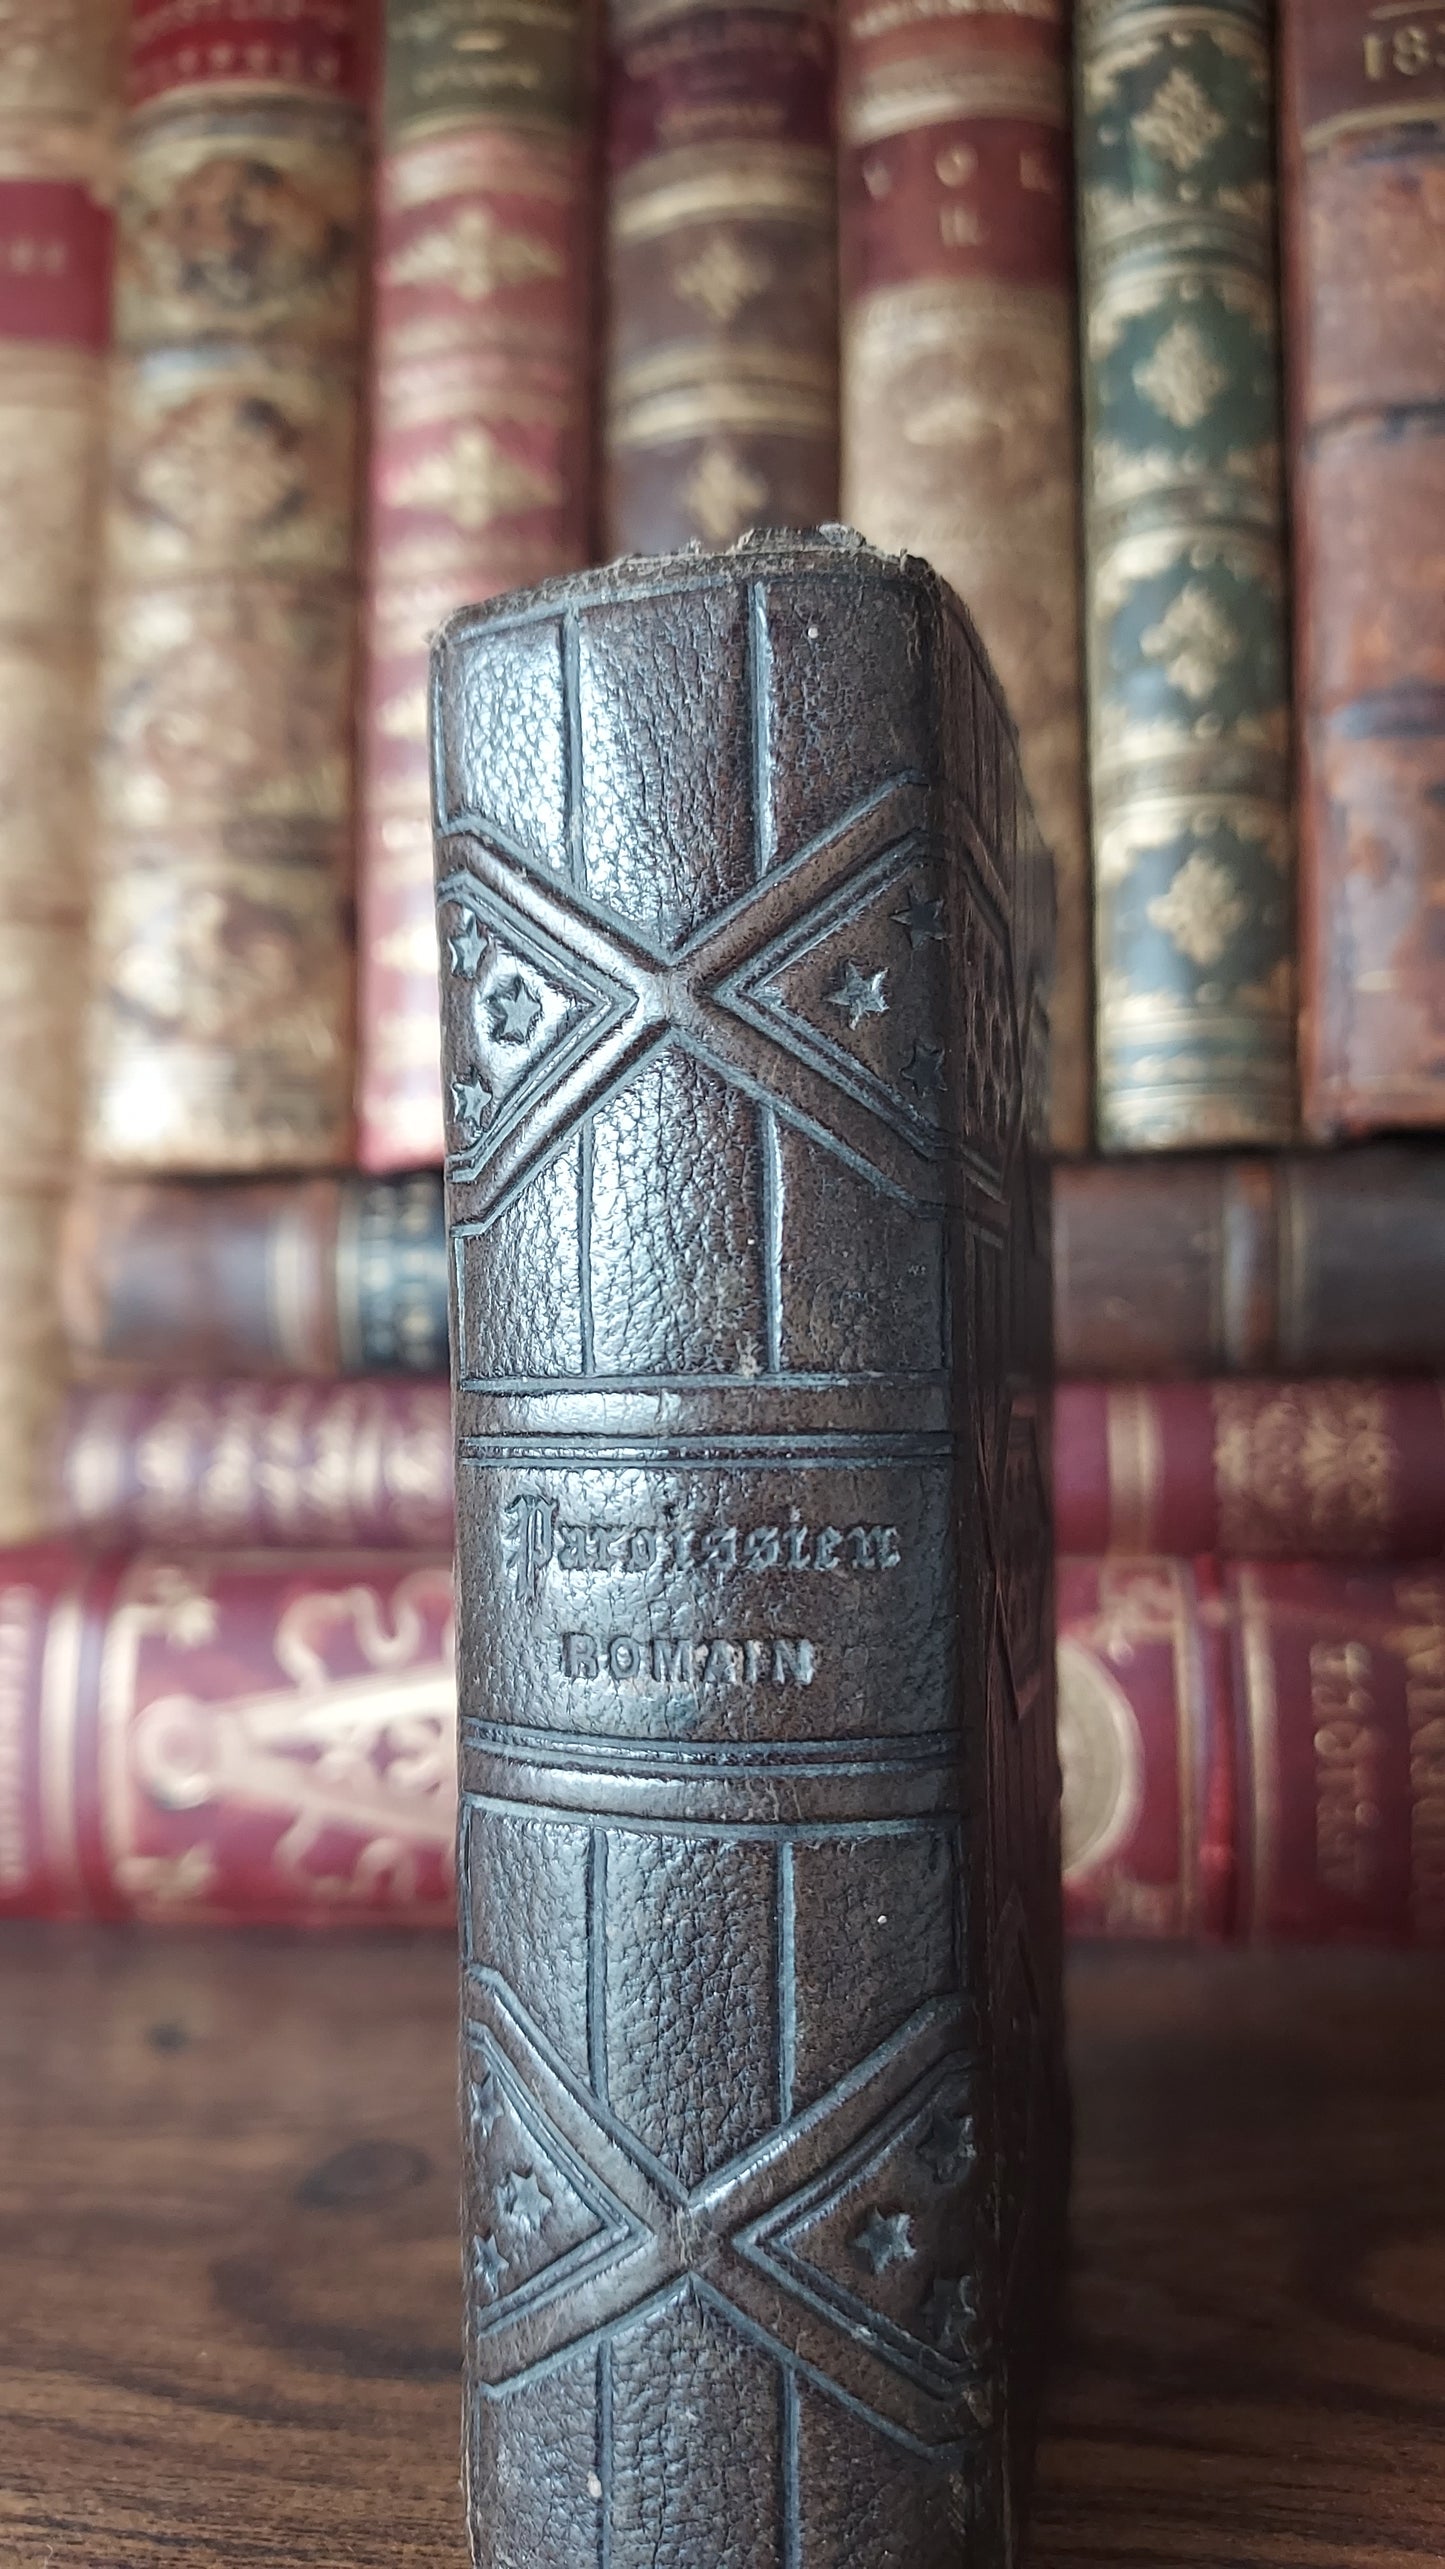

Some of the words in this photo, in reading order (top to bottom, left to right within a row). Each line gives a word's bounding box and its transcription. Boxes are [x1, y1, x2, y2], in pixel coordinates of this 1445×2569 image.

[1361, 24, 1445, 80] 18
[504, 1494, 901, 1600] Paroissien
[561, 1632, 815, 1686] ROMAIN
